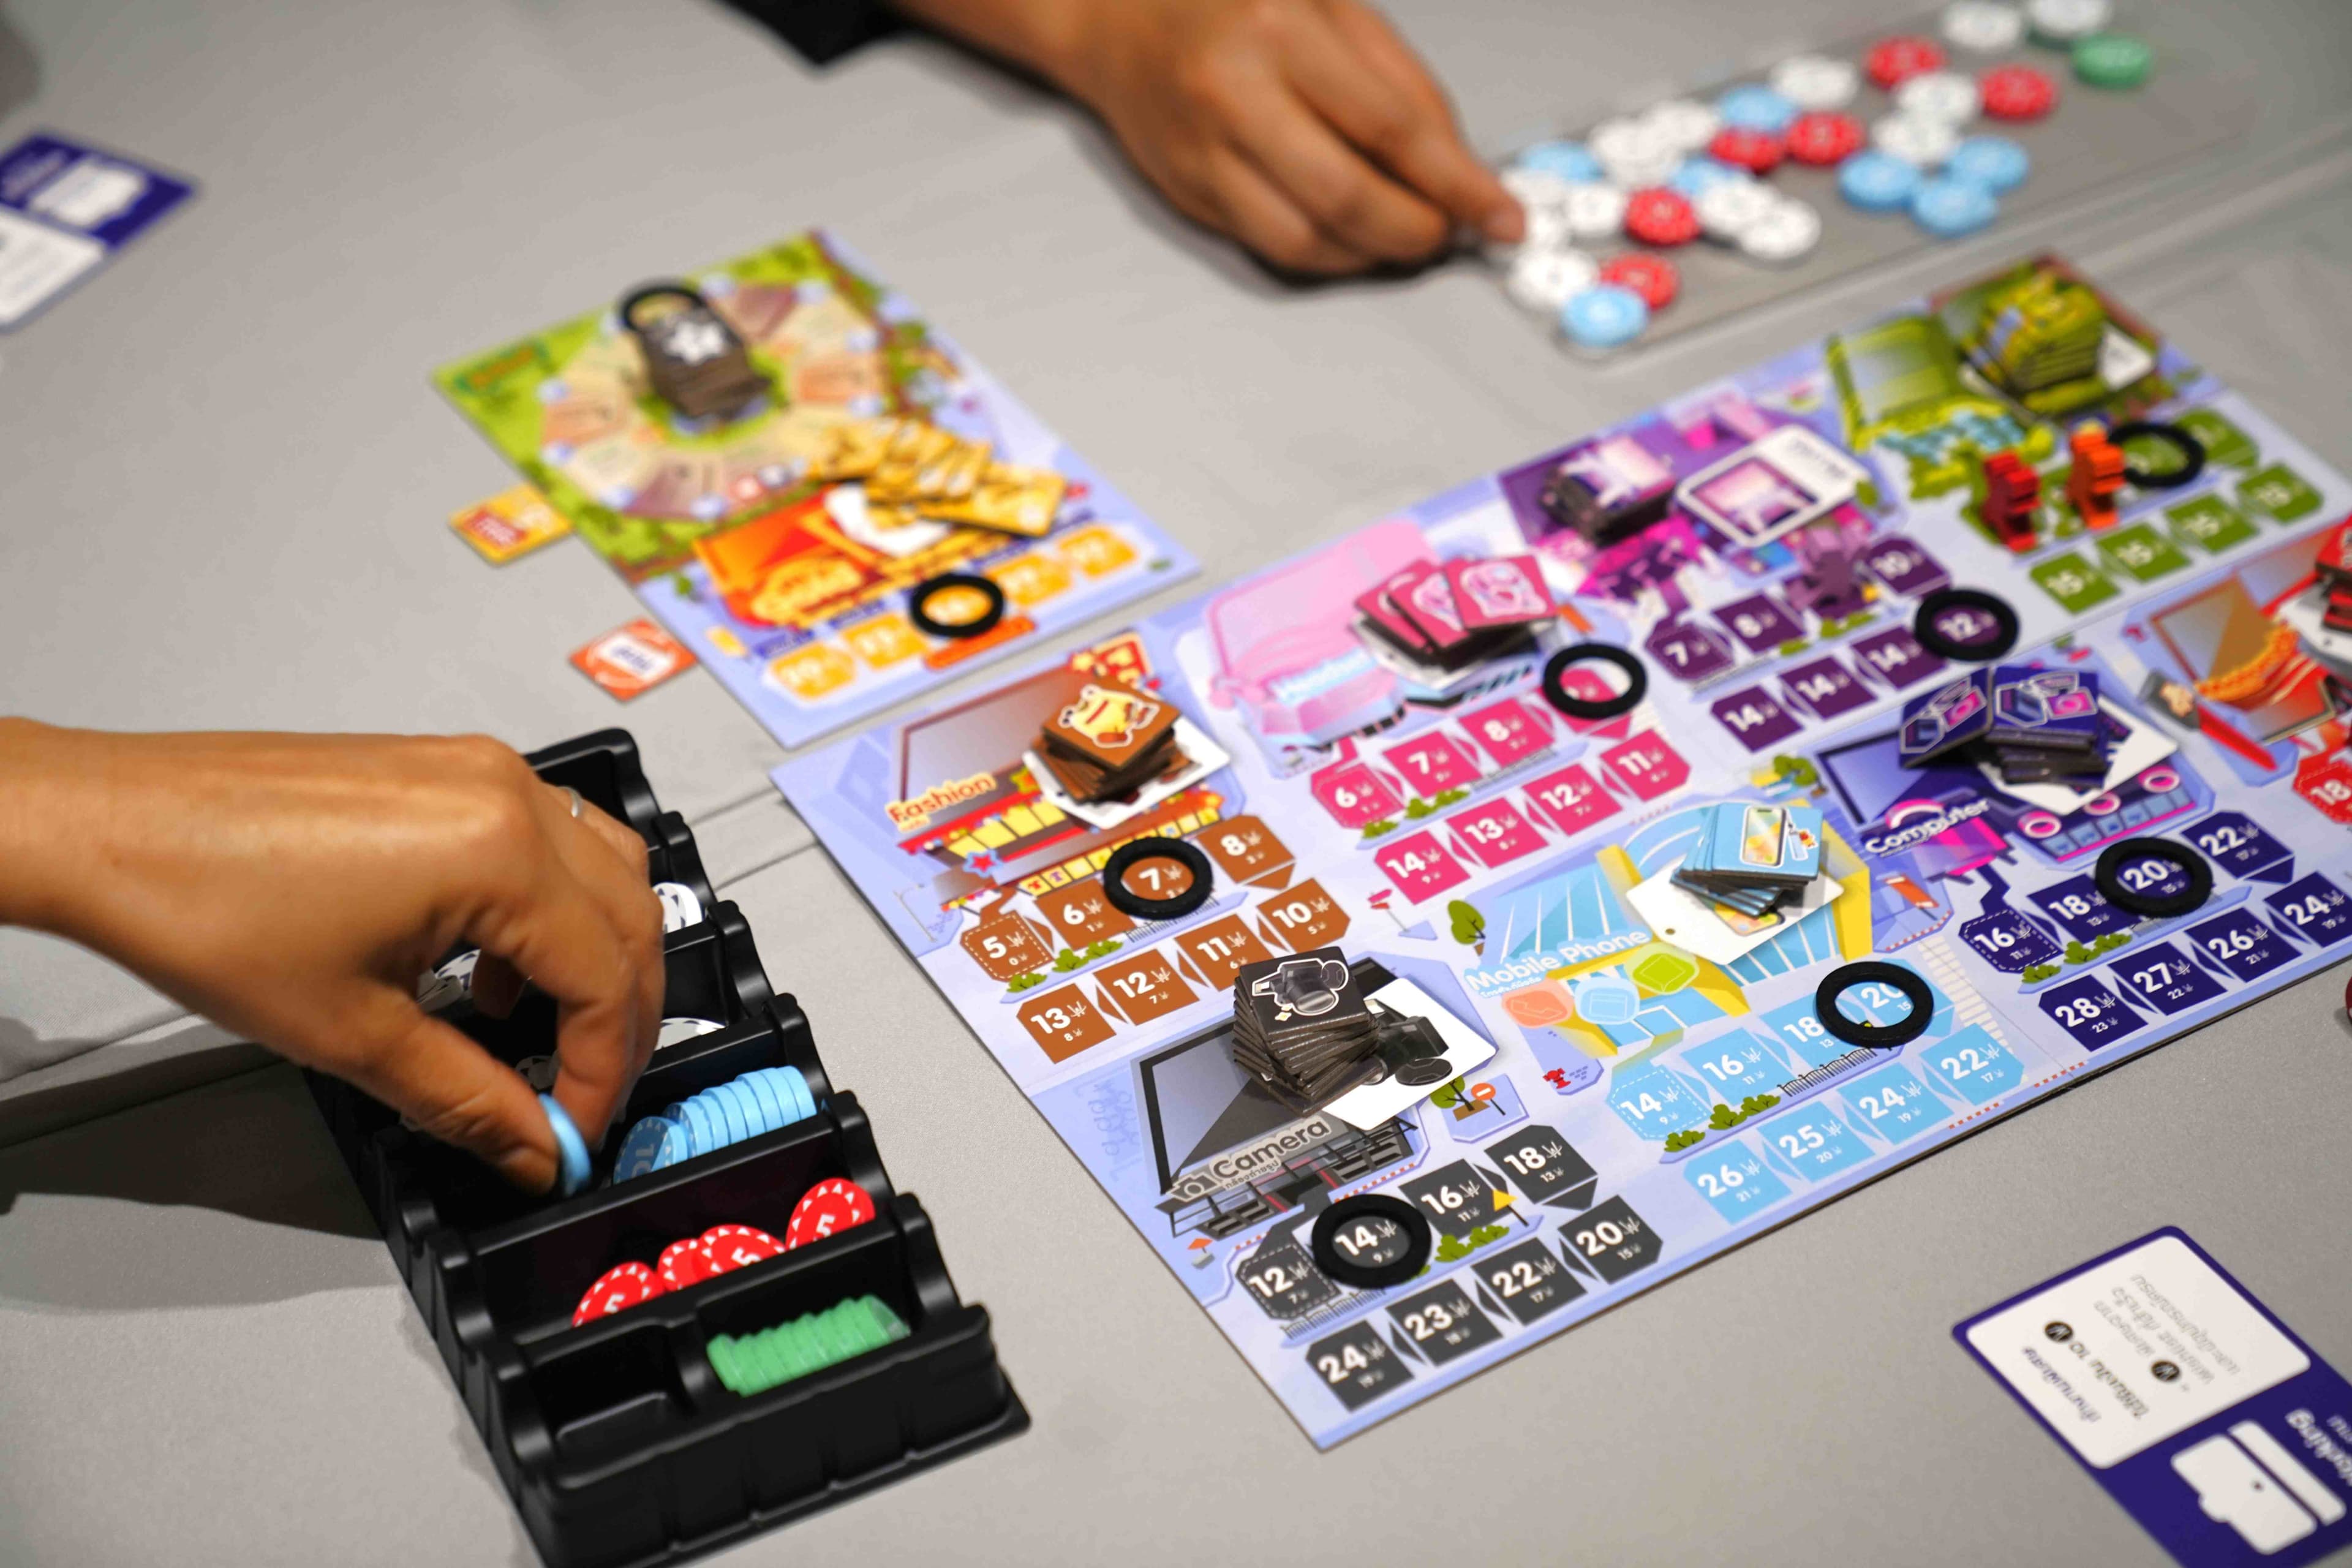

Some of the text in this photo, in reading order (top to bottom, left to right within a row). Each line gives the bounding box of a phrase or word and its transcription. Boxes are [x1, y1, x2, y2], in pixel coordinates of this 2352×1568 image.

[1664, 641, 1688, 666] 7
[1484, 720, 1510, 742] 8
[1408, 752, 1430, 775] 7
[1618, 751, 1652, 775] 11
[888, 775, 995, 823] Fashion
[1335, 787, 1357, 808] 6
[1540, 784, 1581, 810] 12
[1465, 818, 1504, 843] 13
[1865, 799, 1991, 853] Computer
[1221, 834, 1246, 856] 8
[2199, 826, 2246, 856] 22
[1386, 852, 1426, 878] 14
[2124, 860, 2168, 889] 20
[1138, 867, 1160, 891] 7
[1063, 904, 1085, 924] 6
[1272, 902, 1311, 929] 10
[2048, 895, 2091, 920] 18
[2283, 895, 2331, 925] 24
[982, 936, 1007, 958] 5
[1197, 937, 1231, 962] 11
[1974, 927, 2015, 952] 16
[2208, 930, 2254, 960] 26
[1464, 956, 1561, 990] Mobile
[1559, 930, 1650, 963] Phone
[1114, 972, 1155, 998] 12
[2133, 962, 2173, 993] 27
[1149, 995, 1158, 1004] 7
[2168, 989, 2185, 1000] 22
[1031, 1008, 1071, 1034] 13
[2055, 998, 2101, 1028] 28
[1064, 1033, 1073, 1041] 8
[1783, 1016, 1825, 1042] 18
[2092, 1022, 2109, 1033] 23
[1820, 1038, 1834, 1049] 13
[1703, 1055, 1744, 1080] 16
[1940, 1049, 1989, 1079] 22
[1743, 1075, 1755, 1085] 11
[1981, 1073, 1994, 1084] 17
[1621, 1093, 1662, 1120] 14
[1859, 1087, 1905, 1119] 24
[1659, 1116, 1668, 1125] 9
[1898, 1112, 1911, 1123] 19
[1213, 1120, 1330, 1179] Camera
[1779, 1125, 1825, 1159] 25
[1504, 1147, 1546, 1175] 18
[1816, 1152, 1833, 1164] 20
[1540, 1172, 1556, 1183] 13
[1698, 1165, 1744, 1197] 26
[1421, 1185, 1463, 1215] 16
[1736, 1191, 1751, 1202] 21
[813, 1213, 836, 1242] 5
[1458, 1211, 1471, 1222] 11
[1335, 1226, 1378, 1256] 14
[1576, 1221, 1623, 1256] 20
[1373, 1253, 1382, 1262] 9
[1617, 1248, 1633, 1260] 15
[1249, 1267, 1293, 1298] 12
[1492, 1262, 1542, 1297] 22
[1404, 1305, 1452, 1341] 23
[1318, 1344, 1368, 1383] 24
[2069, 1342, 2090, 1359] 10
[2285, 1408, 2352, 1487] orking
